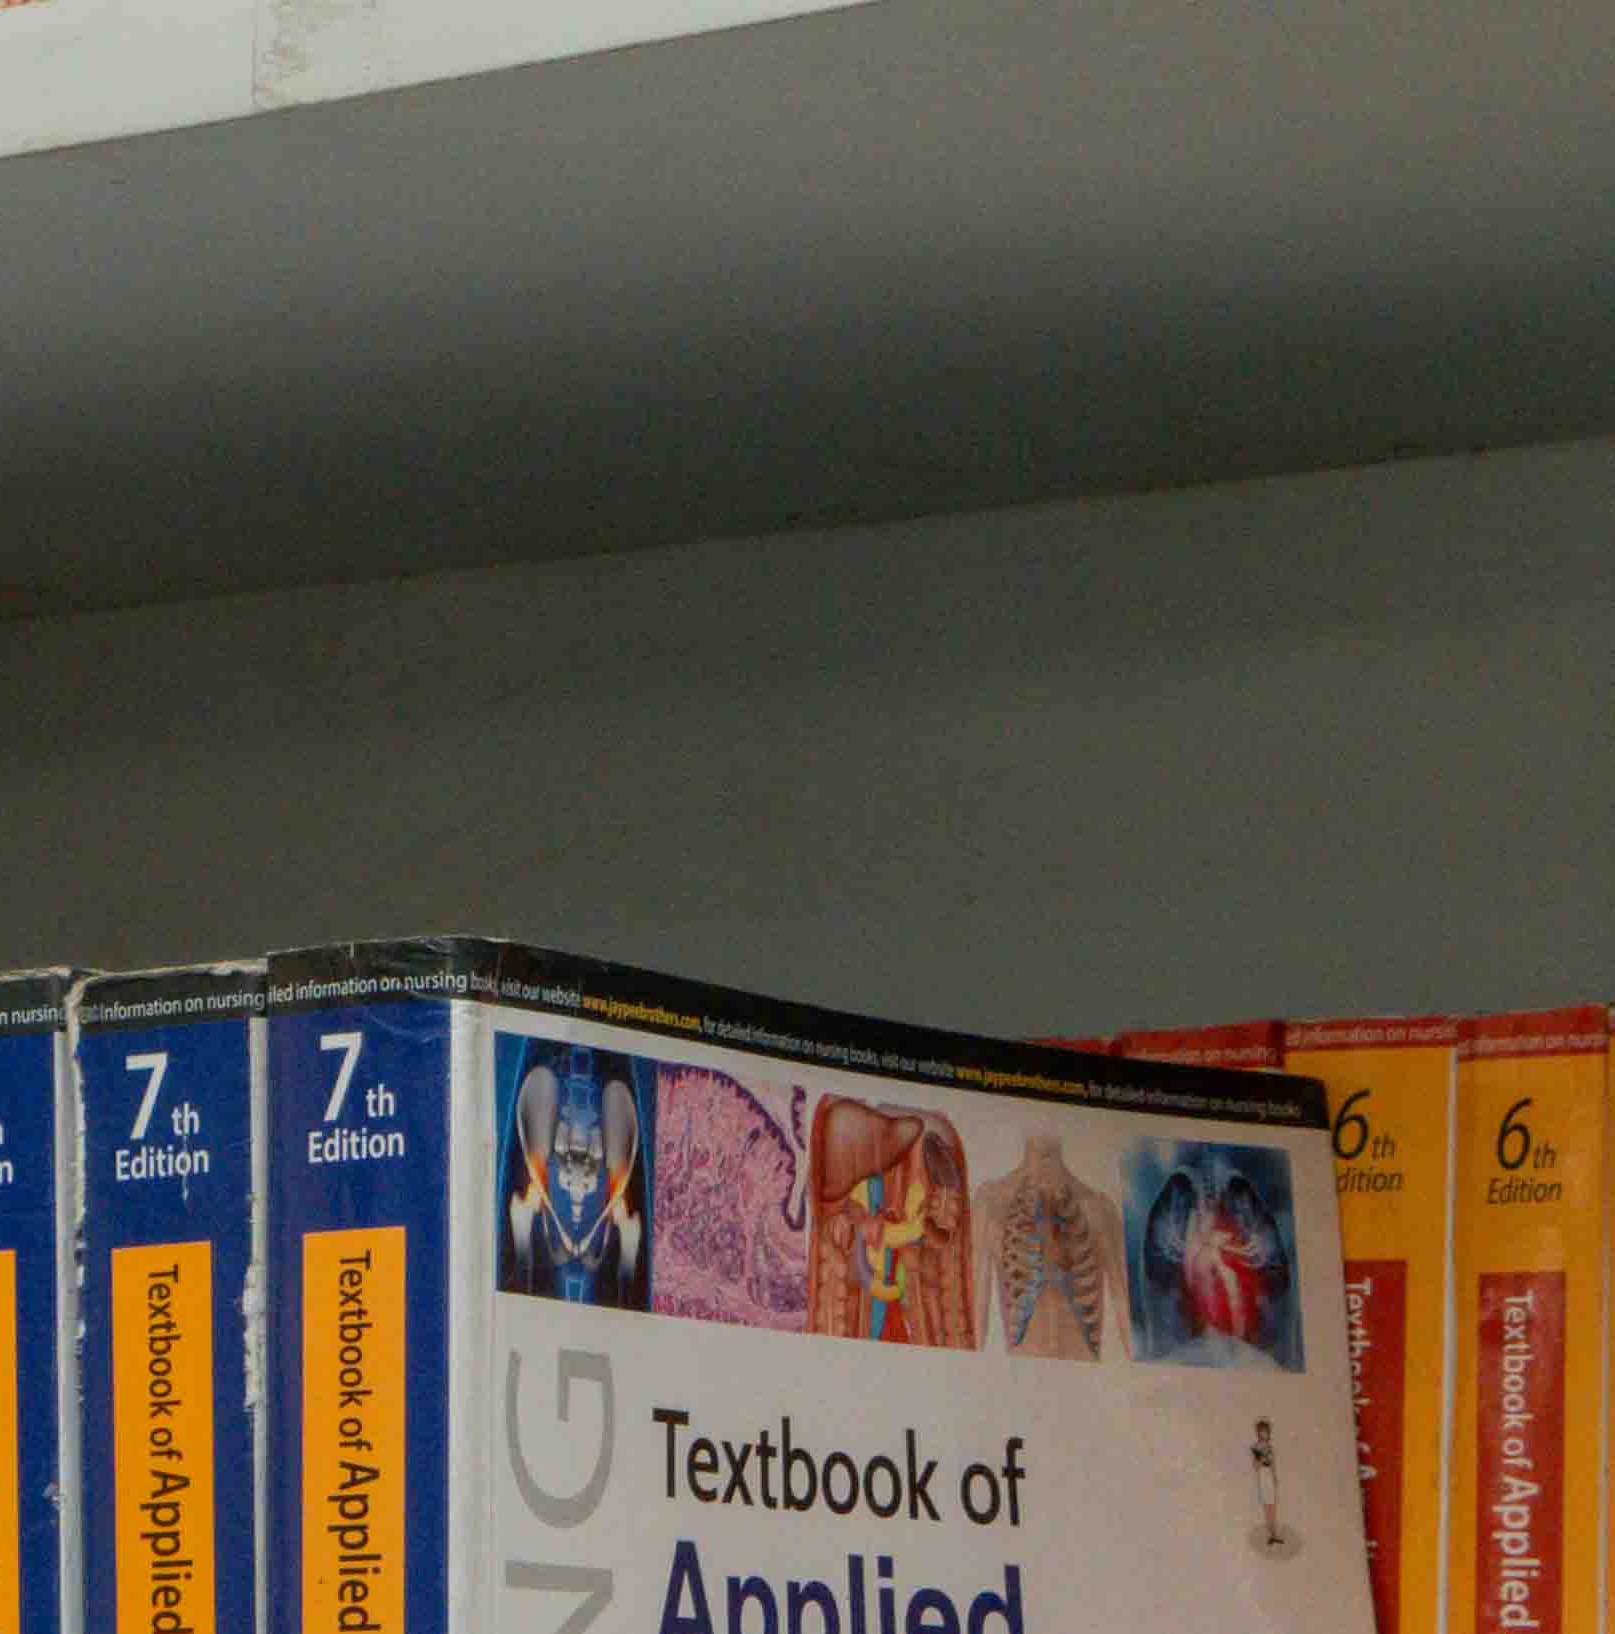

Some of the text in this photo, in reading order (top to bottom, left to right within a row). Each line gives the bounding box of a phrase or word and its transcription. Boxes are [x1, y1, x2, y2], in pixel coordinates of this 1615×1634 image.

[295, 971, 468, 1000] information on nursing
[115, 1146, 211, 1183] Edition
[308, 1128, 405, 1164] Edition
[1487, 1178, 1562, 1207] Edition
[149, 1264, 181, 1417] Textbook
[338, 1251, 372, 1407] Textbook
[1501, 1295, 1535, 1429] Textbook
[150, 1427, 182, 1459] of
[338, 1418, 372, 1450] of
[652, 1407, 1026, 1527] Textbook of
[1501, 1439, 1533, 1467] of
[141, 1471, 193, 1634] Applied
[327, 1462, 381, 1631] Applied
[1493, 1475, 1540, 1627] Applied
